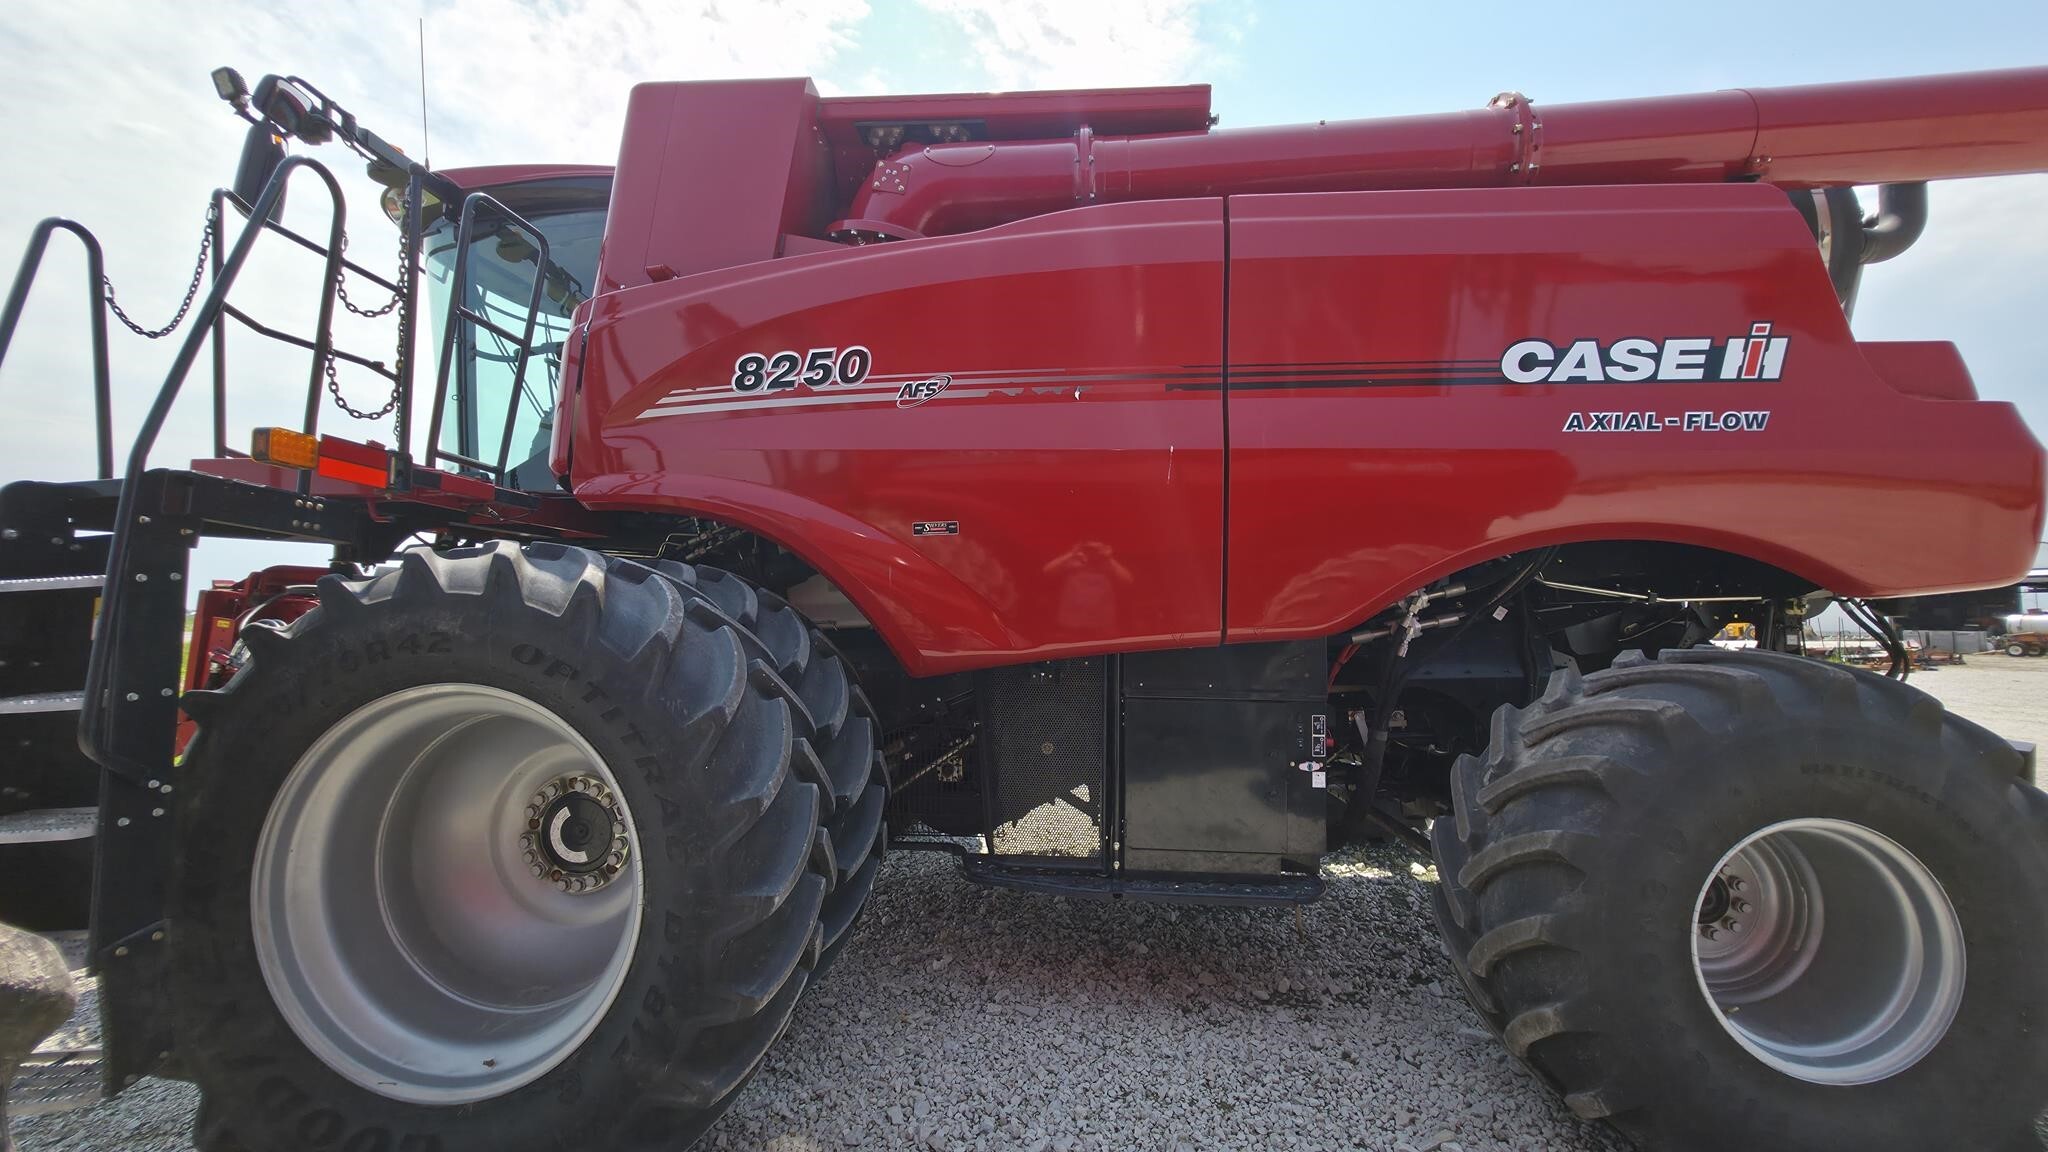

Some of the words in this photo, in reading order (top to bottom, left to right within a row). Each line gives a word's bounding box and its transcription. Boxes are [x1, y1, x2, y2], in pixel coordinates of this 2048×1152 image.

[732, 345, 872, 394] 8250
[1501, 338, 1713, 383] CASE
[896, 380, 940, 401] AFS
[1562, 411, 1770, 432] AXIAL-FLOW
